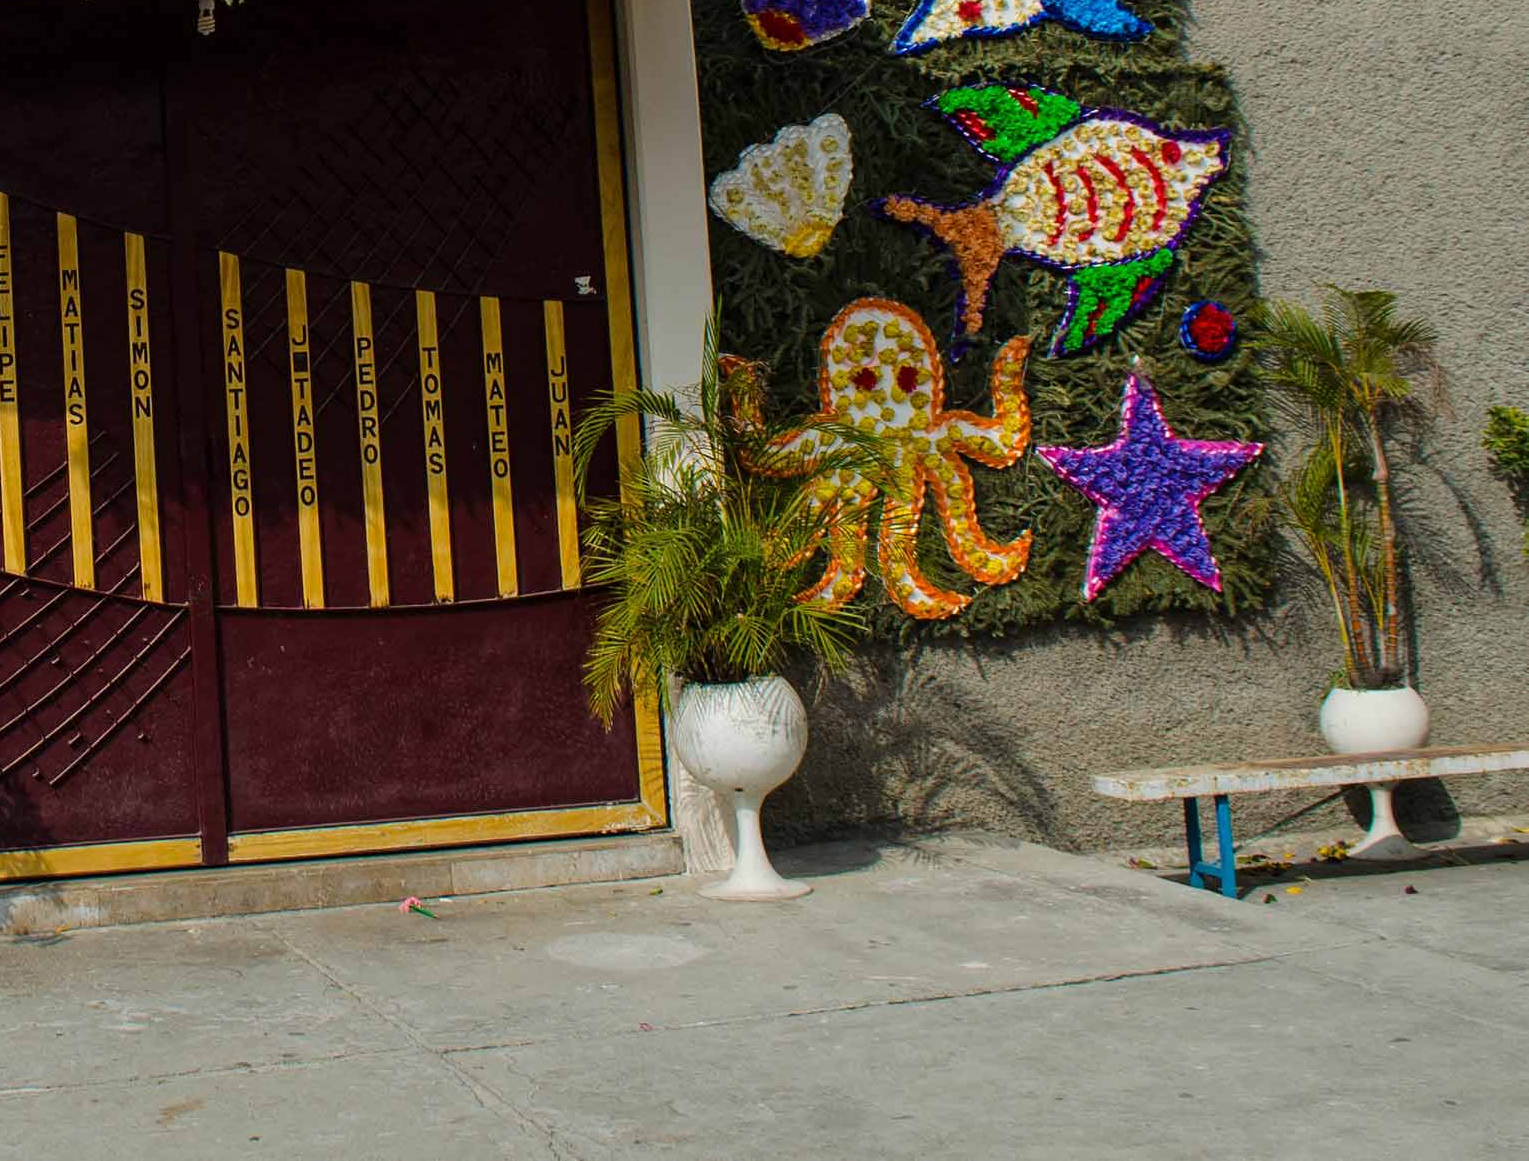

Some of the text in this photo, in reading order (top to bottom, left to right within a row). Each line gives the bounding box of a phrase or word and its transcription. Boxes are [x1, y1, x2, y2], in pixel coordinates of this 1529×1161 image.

[61, 269, 85, 426] MATIAS
[129, 288, 152, 418] SIMON
[356, 337, 379, 465] PEDRO
[422, 346, 444, 475] TOMAS
[550, 356, 570, 456] JUAN
[225, 308, 249, 517] SANTIAGO
[485, 352, 509, 479] MATEO
